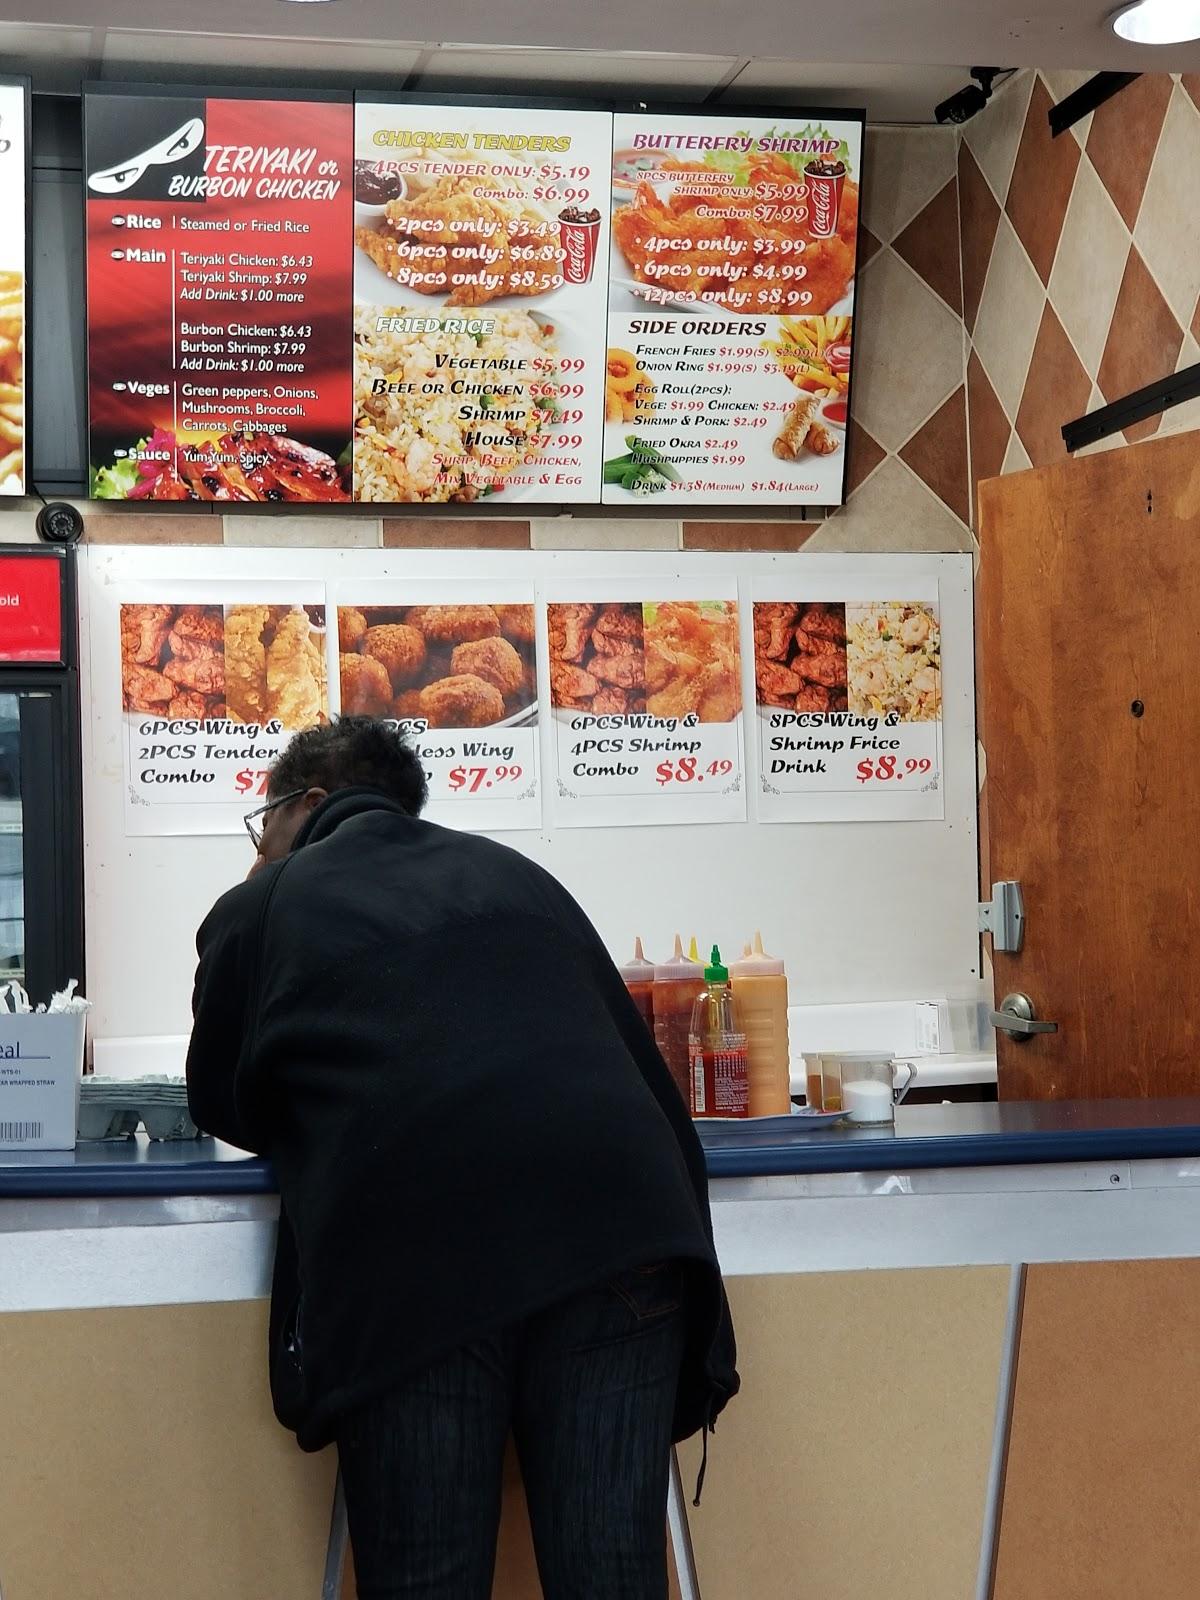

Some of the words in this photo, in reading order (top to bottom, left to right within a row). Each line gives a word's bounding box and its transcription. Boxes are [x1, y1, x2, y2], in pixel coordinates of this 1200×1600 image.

[373, 130, 468, 149] CHICKEN
[473, 134, 571, 152] TENDERS
[633, 134, 753, 152] BUTTERFRY
[757, 137, 840, 153] SHRIMP
[203, 146, 317, 174] TERIYAKI
[318, 160, 339, 176] or
[373, 161, 419, 177] 4PCS
[424, 163, 486, 176] TENDER
[491, 165, 536, 178] ONLY:
[540, 165, 590, 181] $5.19
[669, 172, 734, 182] BUTTERFRY
[168, 175, 252, 198] BURBON
[255, 178, 340, 200] CHICKEN
[473, 187, 528, 199] Combo:
[532, 186, 590, 203] $6.99
[674, 186, 719, 195] SHRIMP
[721, 187, 753, 196] ONLY:
[756, 184, 809, 200] $5.99
[697, 206, 751, 217] Combo:
[754, 205, 808, 222] $7.99
[127, 215, 161, 229] Rice
[181, 219, 230, 231] Steamed
[235, 222, 247, 231] or
[251, 220, 281, 232] Fried
[285, 221, 310, 233] Rice
[396, 217, 444, 233] 2pcs
[450, 217, 502, 238] only:
[508, 220, 561, 238] $3.49
[397, 241, 447, 260] 6pcs
[452, 242, 504, 265] only:
[510, 245, 567, 263] $6.89
[644, 236, 692, 251] 4pcs
[697, 236, 747, 256] only:
[753, 239, 806, 255] $3.99
[127, 248, 165, 263] Main
[180, 252, 225, 267] Teriyaki
[229, 254, 279, 267] Chicken:
[281, 255, 312, 268] $6.43
[180, 270, 225, 284] Teriyaki
[229, 272, 272, 285] Shrimp:
[275, 273, 306, 285] $7.99
[644, 261, 692, 279] 6pcs
[697, 261, 748, 281] only:
[753, 264, 807, 280] $4.99
[397, 268, 447, 286] 8pcs
[452, 269, 504, 291] only:
[509, 271, 564, 289] $8.59
[180, 289, 201, 300] Add
[206, 289, 238, 301] Drink:
[241, 290, 273, 302] $1.00
[276, 293, 304, 302] more
[644, 289, 696, 303] 12pcs
[701, 288, 752, 309] only:
[757, 290, 813, 305] $8.99
[181, 323, 224, 335] Burbon
[228, 324, 277, 337] Chicken:
[280, 325, 311, 338] $6.43
[376, 317, 439, 334] FRIED
[444, 319, 495, 335] RICE
[628, 320, 677, 334] SIDE
[682, 321, 767, 336] ORDERS
[181, 340, 224, 353] Burbon
[228, 342, 271, 355] Shrimp:
[274, 343, 305, 356] $7.99
[181, 359, 201, 370] Add
[206, 359, 238, 371] Drink:
[241, 360, 273, 372] $1.00
[277, 363, 304, 372] more
[532, 358, 585, 373] $5.99
[128, 381, 170, 397] Veges
[182, 384, 219, 397] Green
[223, 386, 271, 401] peppers,
[274, 386, 318, 400] Onions,
[529, 382, 585, 399] $6.99
[182, 402, 253, 415] Mushrooms,
[256, 403, 305, 416] Broccoli,
[671, 401, 704, 411] $1.99
[762, 402, 797, 412] $2.49
[531, 408, 584, 424] $7.49
[681, 416, 690, 426] &
[733, 417, 767, 427] $2.49
[182, 419, 231, 432] Carrots,
[233, 420, 287, 434] Cabbages
[530, 434, 583, 450] $7.99
[705, 439, 738, 449] $2.49
[129, 449, 170, 461] Sauce
[240, 452, 269, 465] Spicy
[712, 454, 745, 466] $1.99
[539, 473, 550, 484] &
[139, 720, 198, 736] 6PCS
[206, 721, 259, 739] Wing
[266, 720, 281, 735] &
[571, 716, 625, 730] 6PCS
[629, 715, 677, 732] Wing
[683, 715, 698, 727] &
[770, 713, 825, 728] 8PCS
[829, 713, 878, 731] Wing
[885, 713, 901, 727] &
[139, 745, 196, 759] 2PCS
[204, 745, 279, 759] Tender
[463, 743, 514, 760] Wing
[571, 739, 623, 755] 4PCS
[629, 738, 702, 753] Shrimp
[770, 736, 844, 752] Shrimp
[850, 736, 900, 749] Frice
[140, 769, 215, 783] Combo
[573, 763, 639, 776] Combo
[656, 757, 733, 785] $8.49
[771, 760, 827, 773] Drink
[856, 755, 931, 783] $8.99
[449, 765, 522, 792] $7.99
